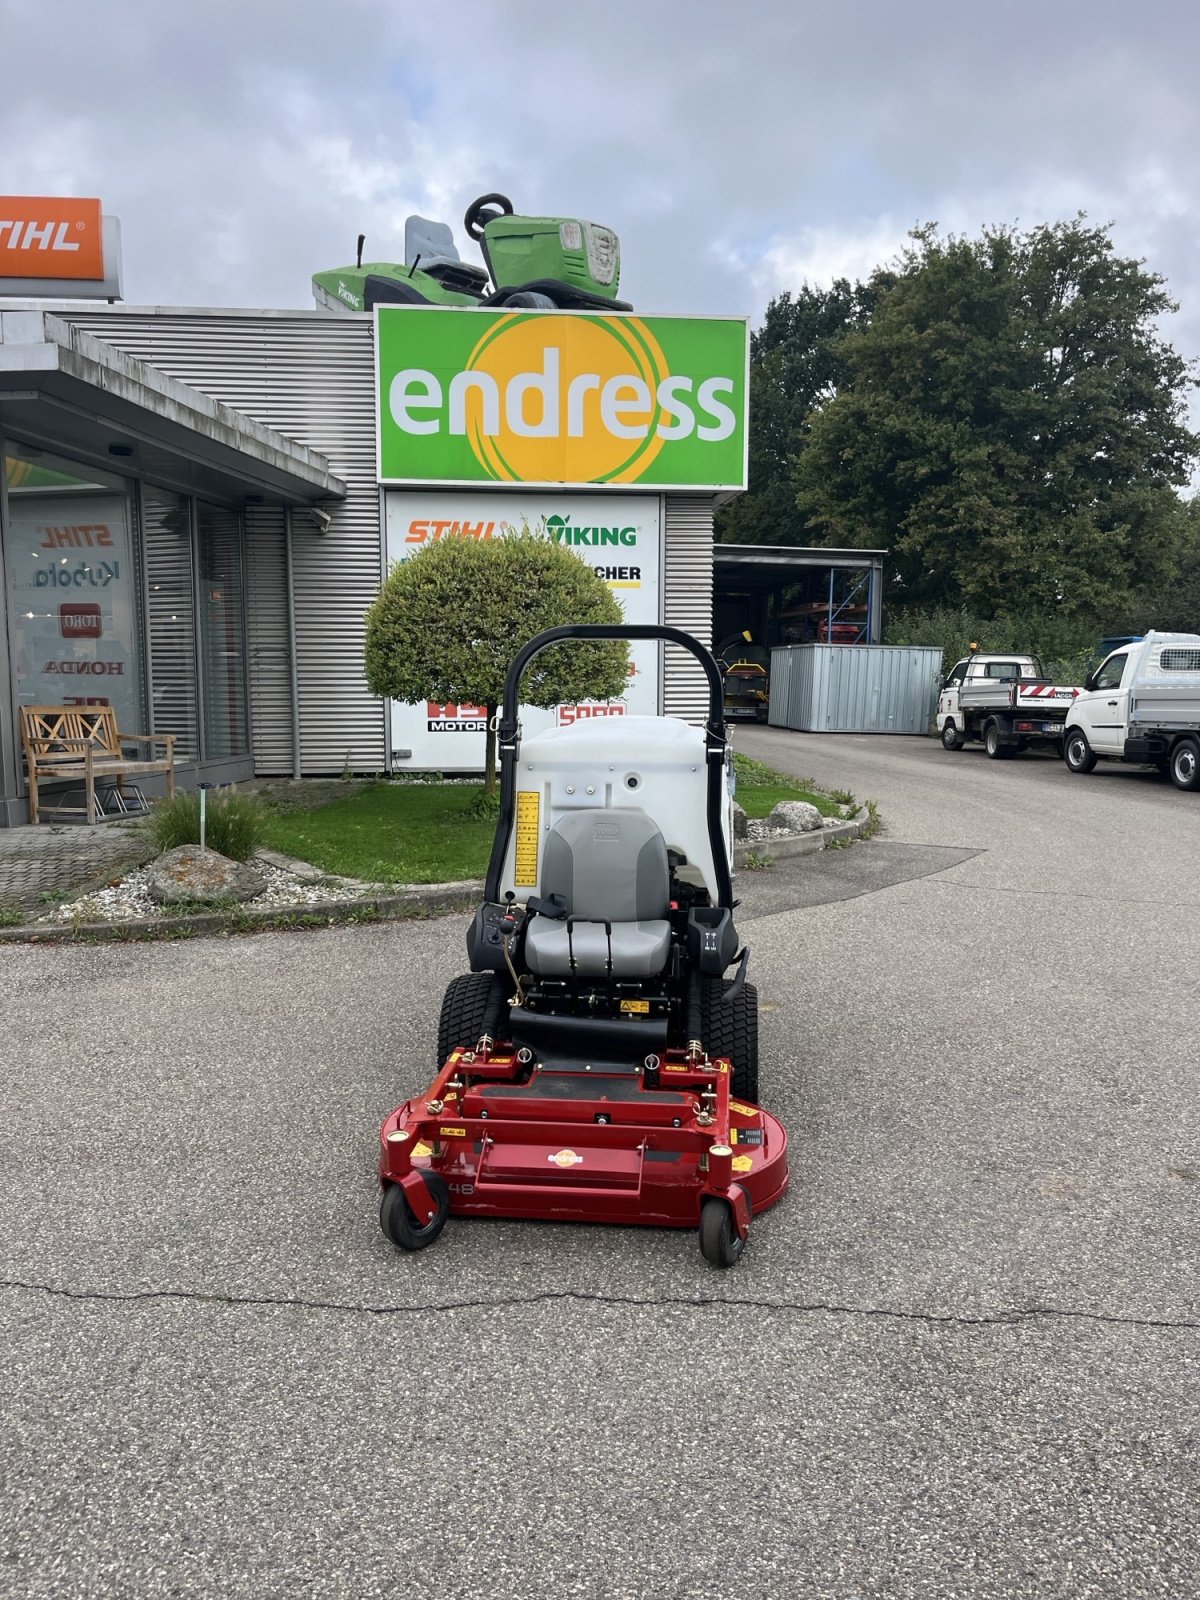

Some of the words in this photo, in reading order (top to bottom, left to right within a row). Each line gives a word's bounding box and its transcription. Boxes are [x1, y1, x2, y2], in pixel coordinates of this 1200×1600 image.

[389, 347, 736, 441] endress
[546, 526, 637, 546] VIKING
[594, 566, 641, 580] CHER
[431, 722, 487, 731] MOTOR
[448, 1183, 474, 1195] 48
